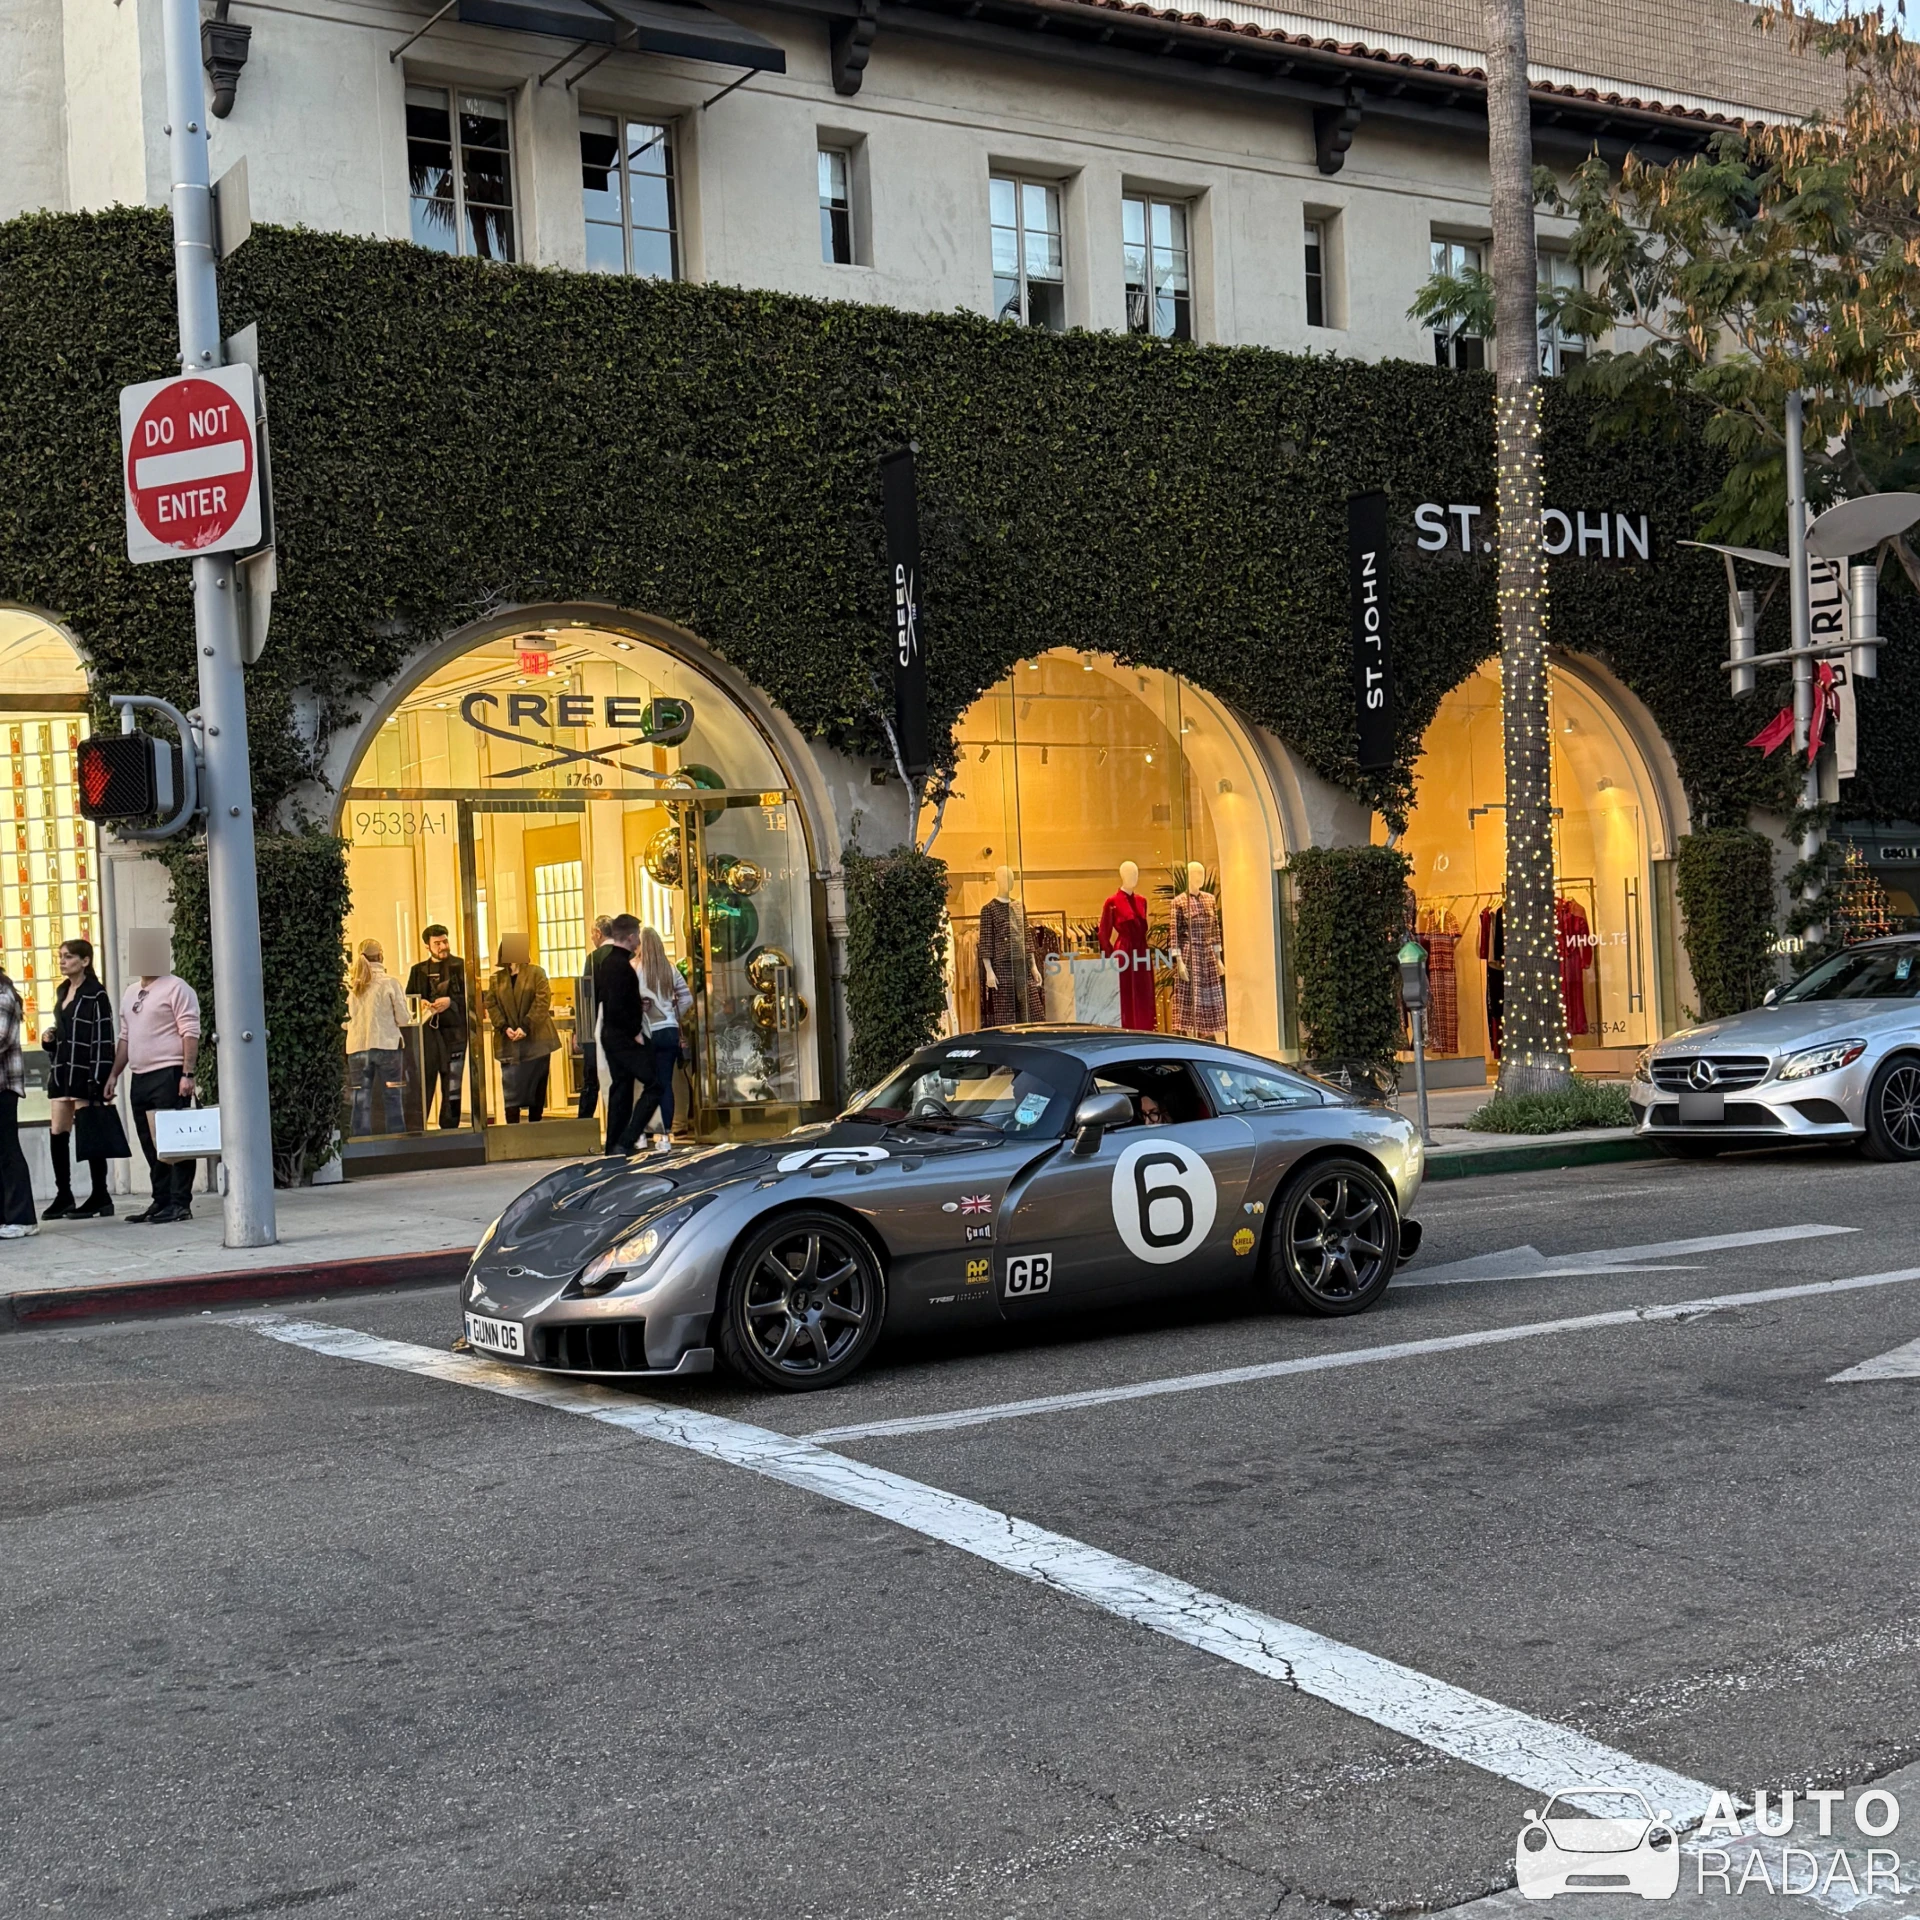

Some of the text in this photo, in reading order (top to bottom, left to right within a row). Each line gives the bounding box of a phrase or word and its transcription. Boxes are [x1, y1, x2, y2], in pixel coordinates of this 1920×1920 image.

[145, 405, 230, 447] DO NOT
[157, 486, 228, 523] ENTER
[1414, 502, 1650, 560] ST. OHN
[896, 563, 910, 667] CREED
[1361, 551, 1384, 710] ST. JOHN
[459, 692, 695, 741] CREED
[565, 773, 604, 787] 1760
[356, 812, 446, 835] 9533A-1
[1043, 948, 1174, 976] ST. JOHN
[1133, 1152, 1194, 1249] 6
[1008, 1257, 1049, 1293] GB
[473, 1318, 518, 1351] GUNN 06
